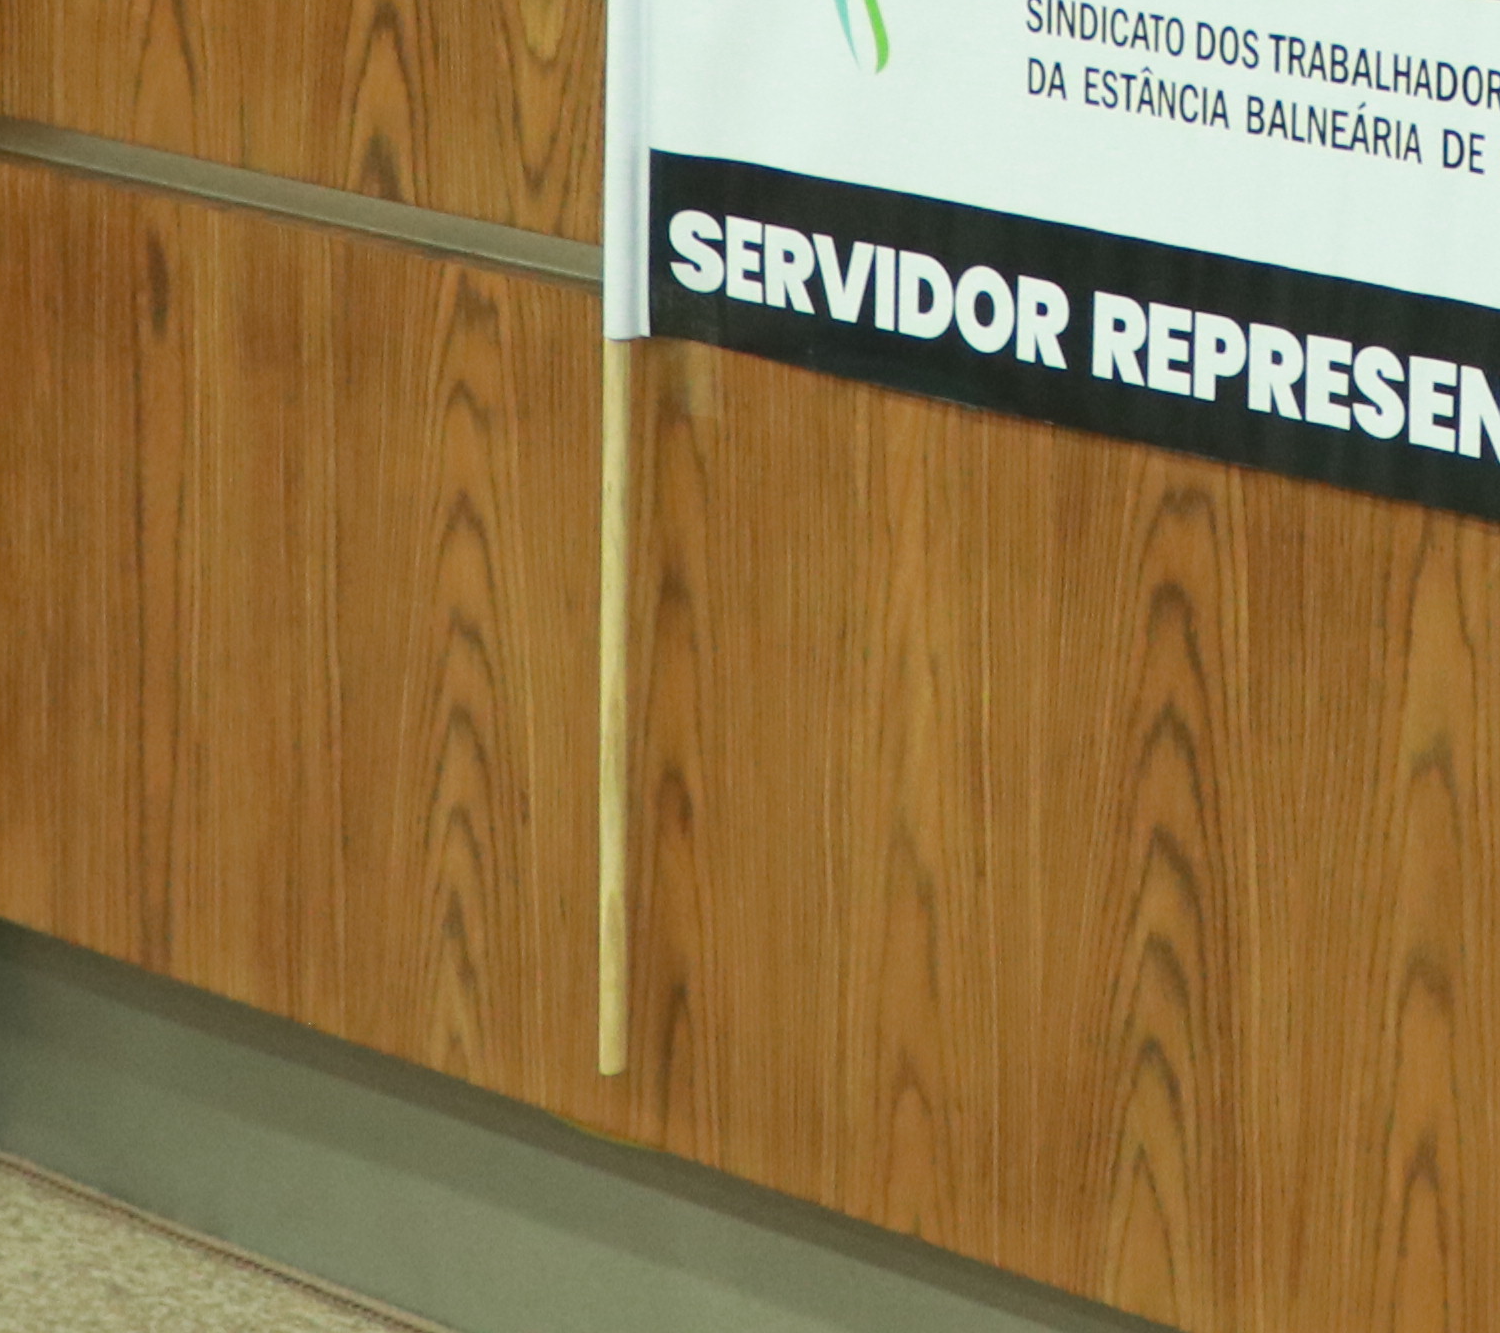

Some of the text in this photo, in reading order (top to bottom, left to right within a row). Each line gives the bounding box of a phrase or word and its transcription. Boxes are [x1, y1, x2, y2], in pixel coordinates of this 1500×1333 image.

[1195, 21, 1260, 70] DOS
[1026, 56, 1067, 102] DA
[1082, 65, 1230, 130] ESTÂNCIA
[1245, 100, 1423, 164] BALNEÁRIA
[1441, 128, 1485, 175] DE
[668, 209, 1069, 370] SERVIDOR
